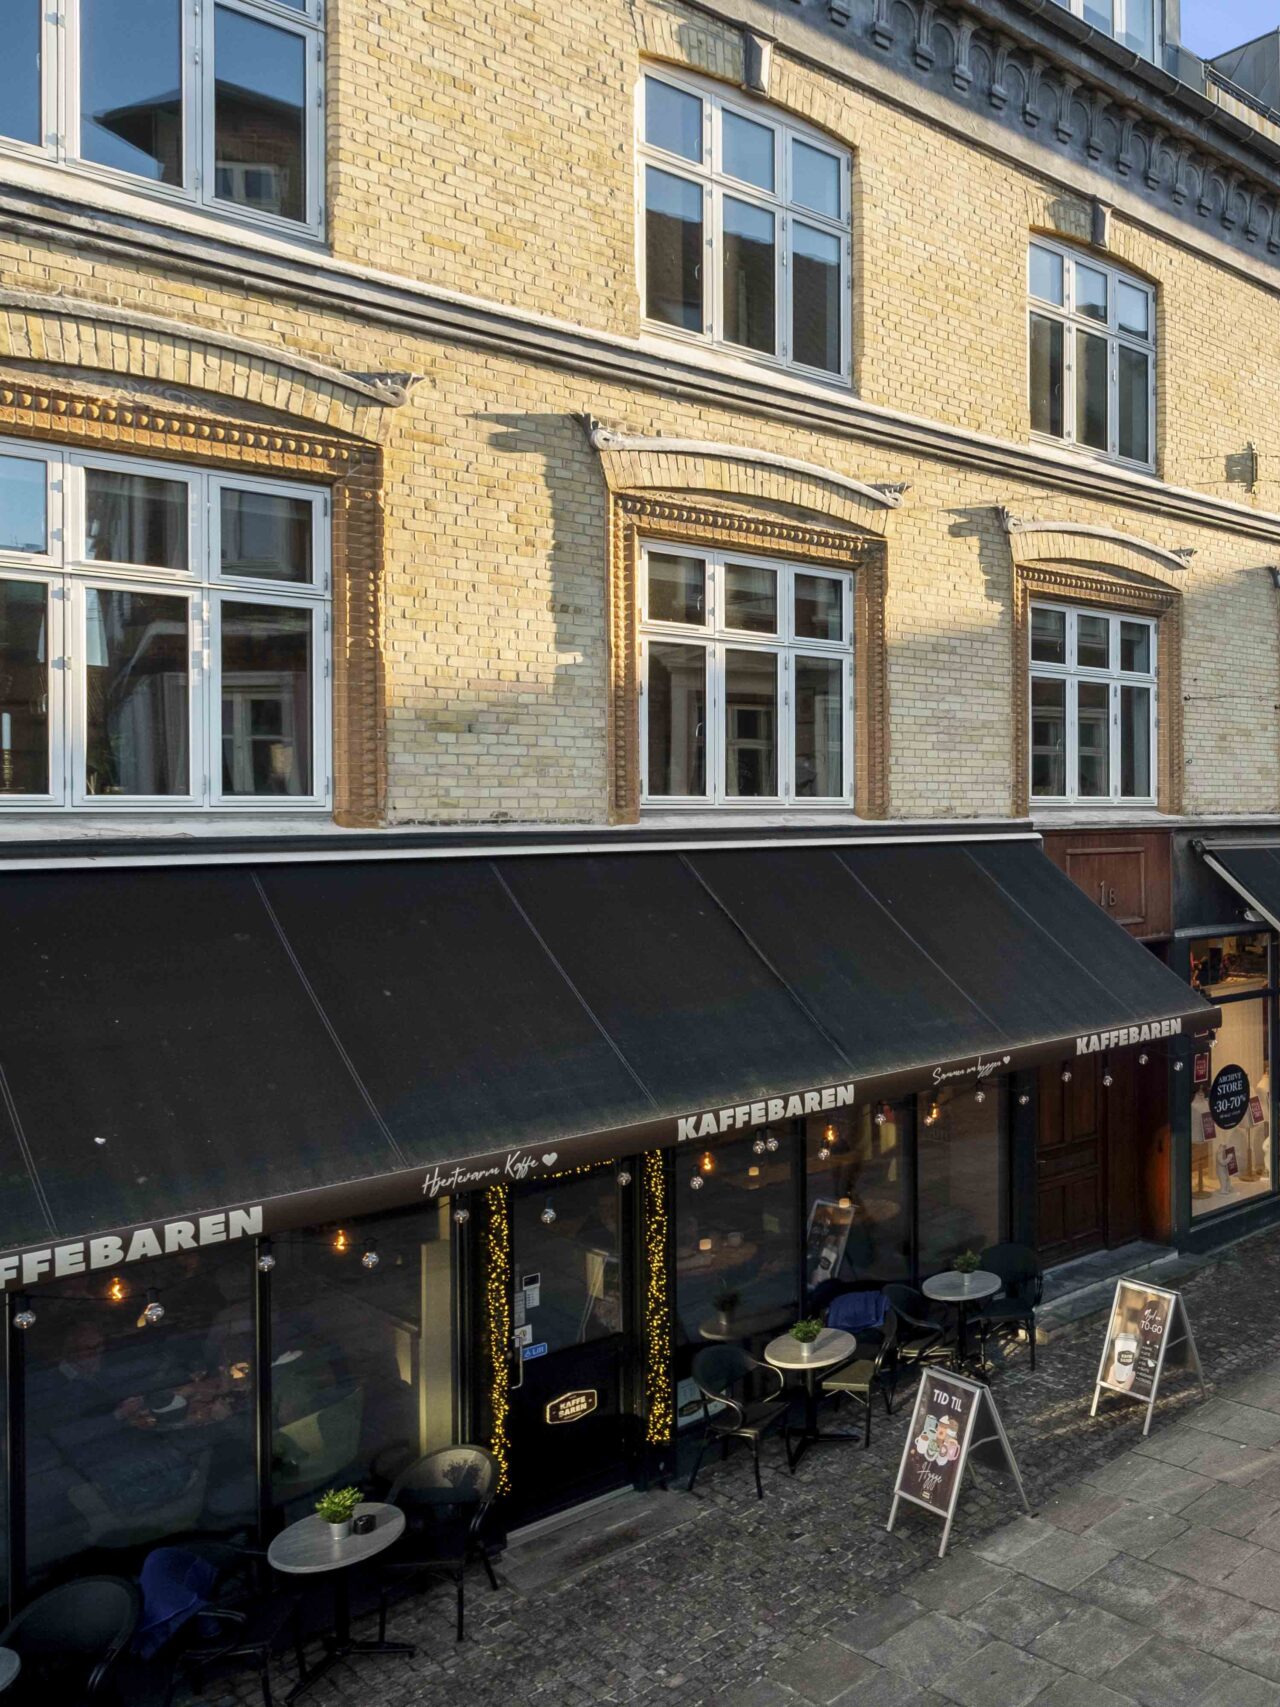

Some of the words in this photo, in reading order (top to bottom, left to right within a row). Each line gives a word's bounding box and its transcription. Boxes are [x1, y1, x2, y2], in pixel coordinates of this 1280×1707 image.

[1076, 1018, 1182, 1055] KAFFEBAREN
[1217, 1080, 1243, 1096] STORE
[677, 1084, 855, 1142] KAFFEBAREN
[504, 1151, 539, 1179] Kaffe
[1140, 1320, 1163, 1335] TO-GO
[558, 1402, 588, 1418] BAREN
[559, 1395, 586, 1410] KAFFE
[933, 1389, 950, 1406] TID
[951, 1396, 962, 1412] TIL
